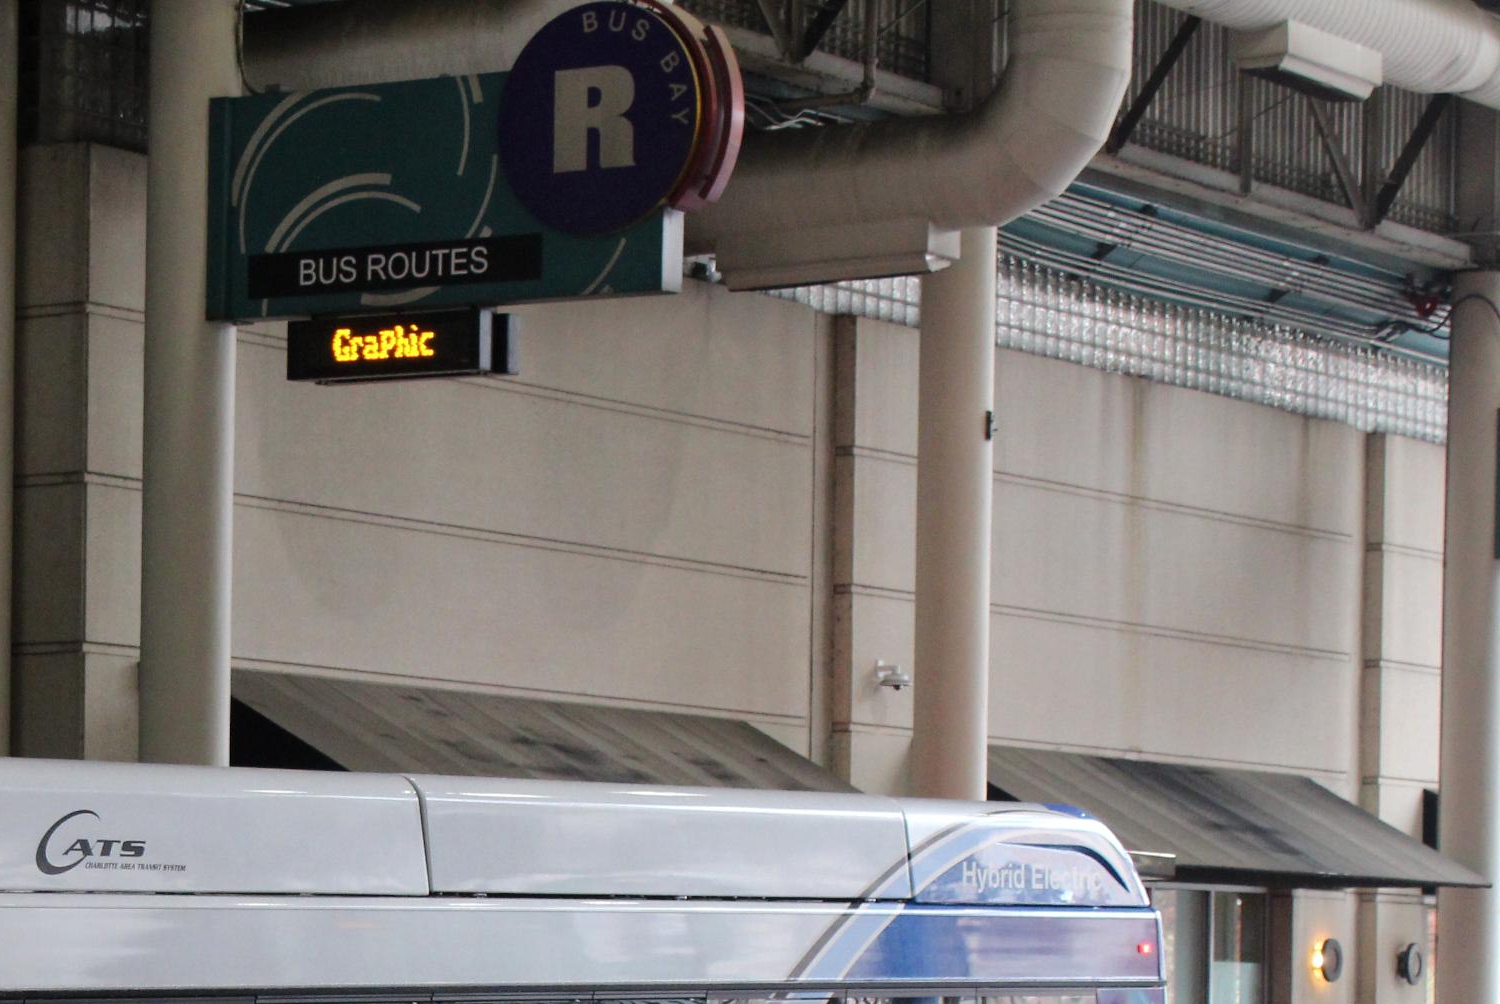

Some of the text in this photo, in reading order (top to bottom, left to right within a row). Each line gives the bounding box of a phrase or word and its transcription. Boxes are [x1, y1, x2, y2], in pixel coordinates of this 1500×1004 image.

[583, 11, 689, 126] BUS BAY
[553, 64, 636, 174] R
[300, 247, 489, 286] BUS ROUTES
[36, 809, 147, 875] CATS
[120, 863, 135, 871] AREA
[962, 861, 1102, 893] Hybrid Electric
